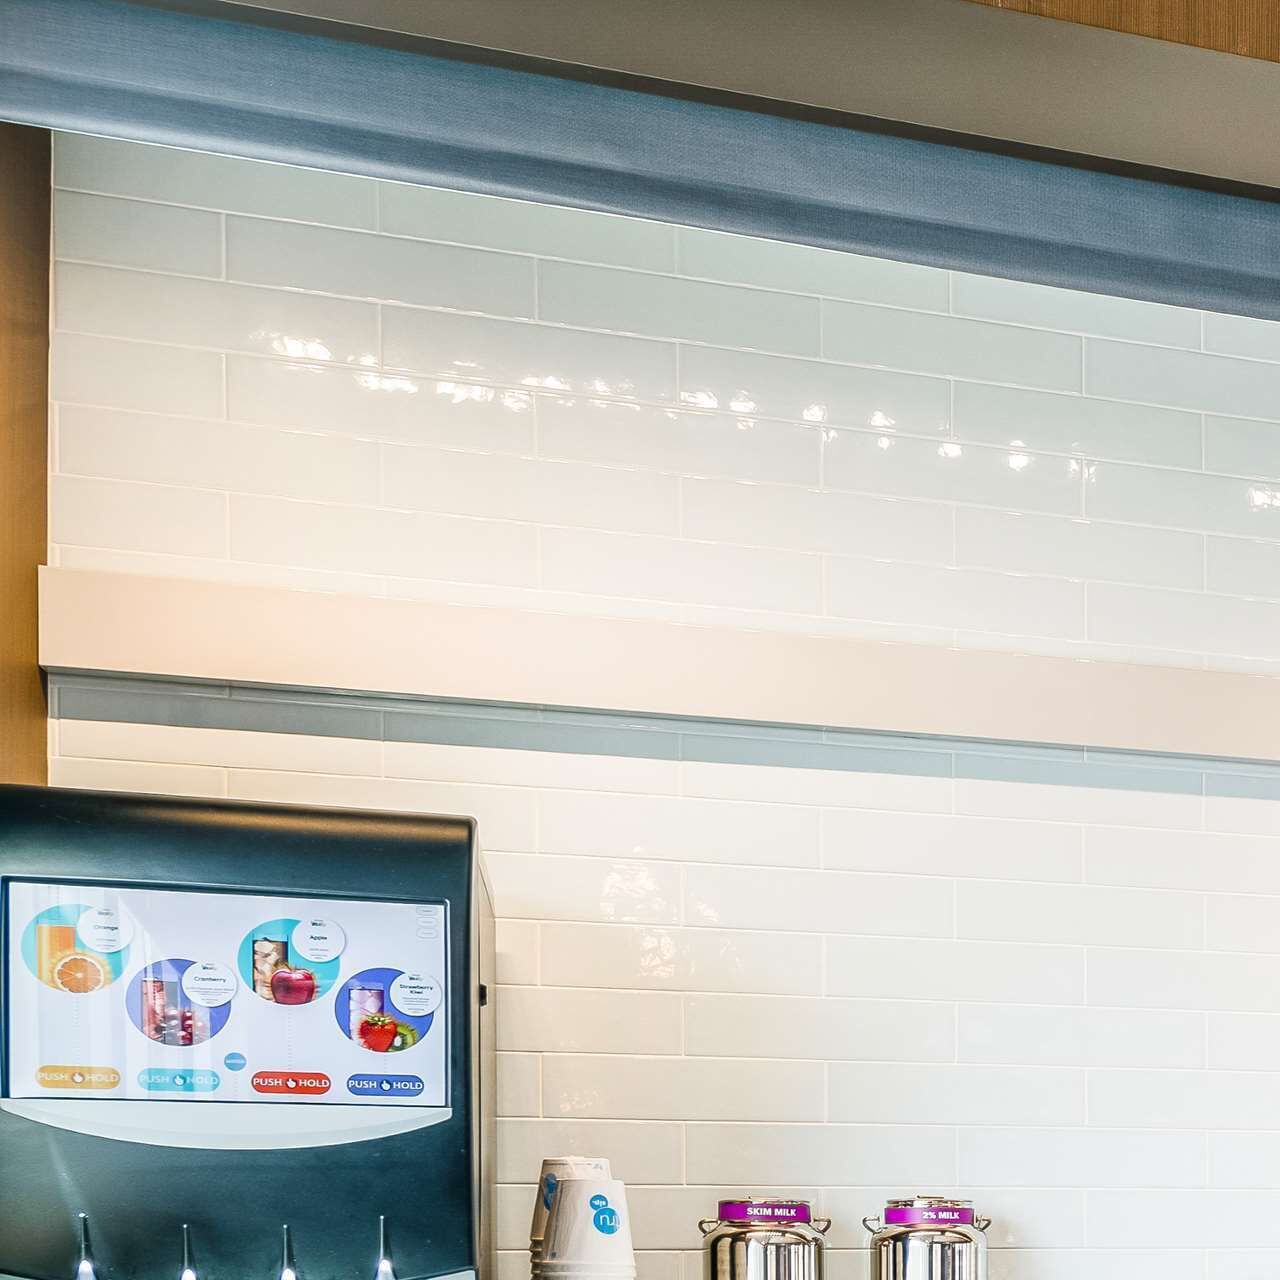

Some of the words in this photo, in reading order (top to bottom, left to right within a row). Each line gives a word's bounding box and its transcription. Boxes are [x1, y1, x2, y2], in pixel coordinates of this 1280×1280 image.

[38, 1073, 68, 1082] PUSH
[87, 1074, 119, 1082] HOLD
[140, 1075, 169, 1084] PUSH
[186, 1076, 218, 1085] HOLD
[253, 1078, 282, 1087] PUSH
[299, 1079, 330, 1088] HOLD
[348, 1080, 377, 1089] PUSH
[392, 1081, 423, 1090] HOLD
[747, 1207, 772, 1216] SKIM
[774, 1207, 797, 1217] MILK
[922, 1211, 937, 1220] 2%
[938, 1211, 960, 1220] MILK
